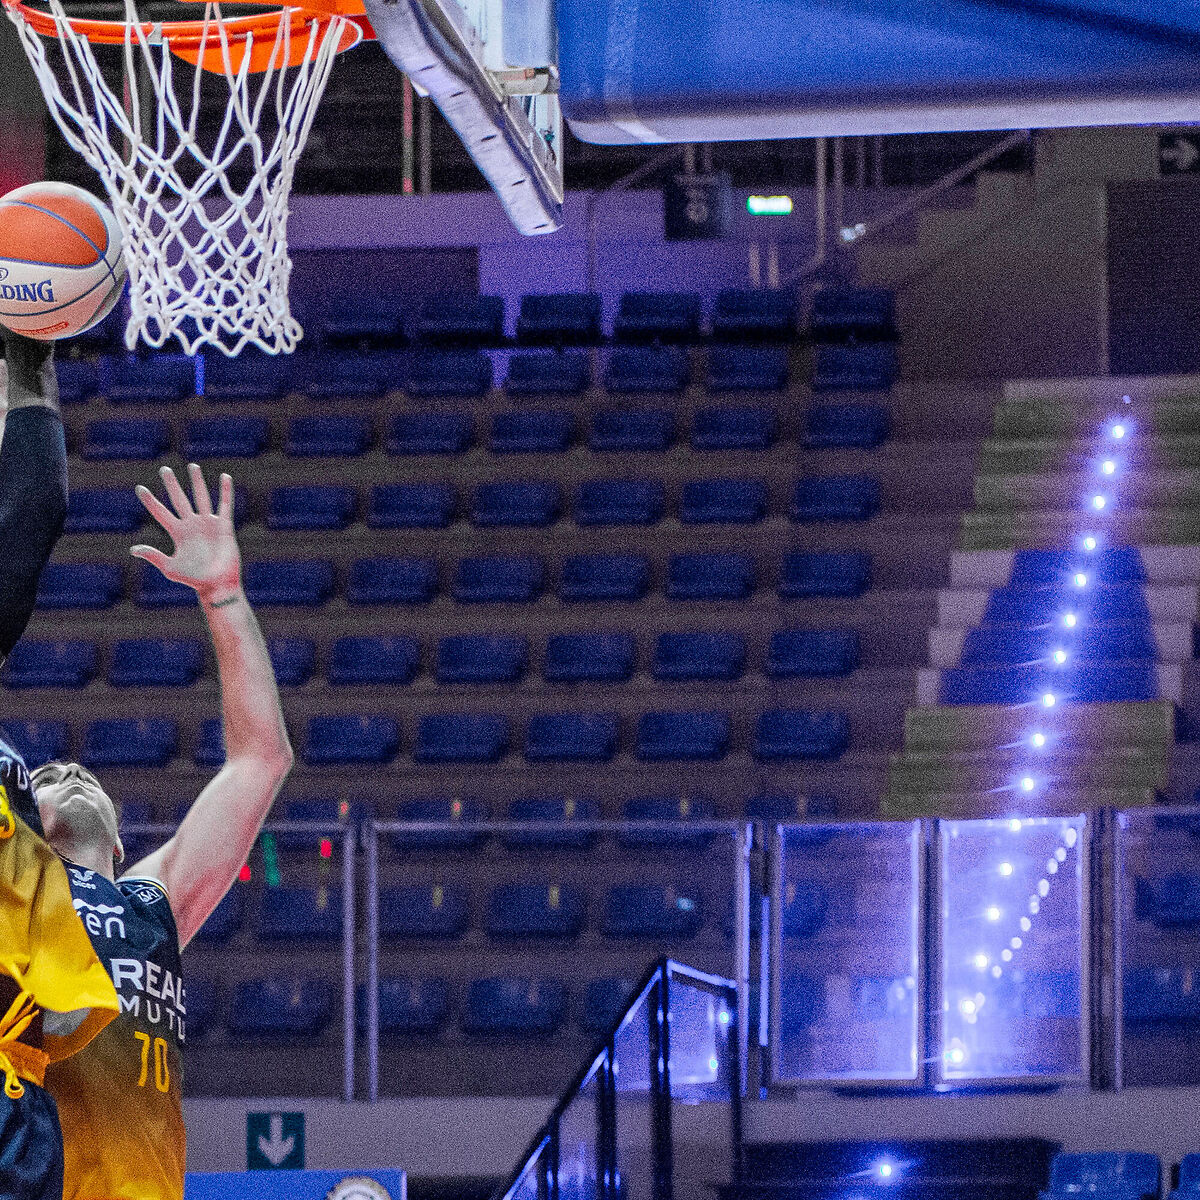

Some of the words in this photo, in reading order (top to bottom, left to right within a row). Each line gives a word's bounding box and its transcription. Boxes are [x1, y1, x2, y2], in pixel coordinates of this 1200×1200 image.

[110, 958, 186, 1014] REAL
[119, 994, 185, 1042] MUTU
[134, 1031, 170, 1093] 70
